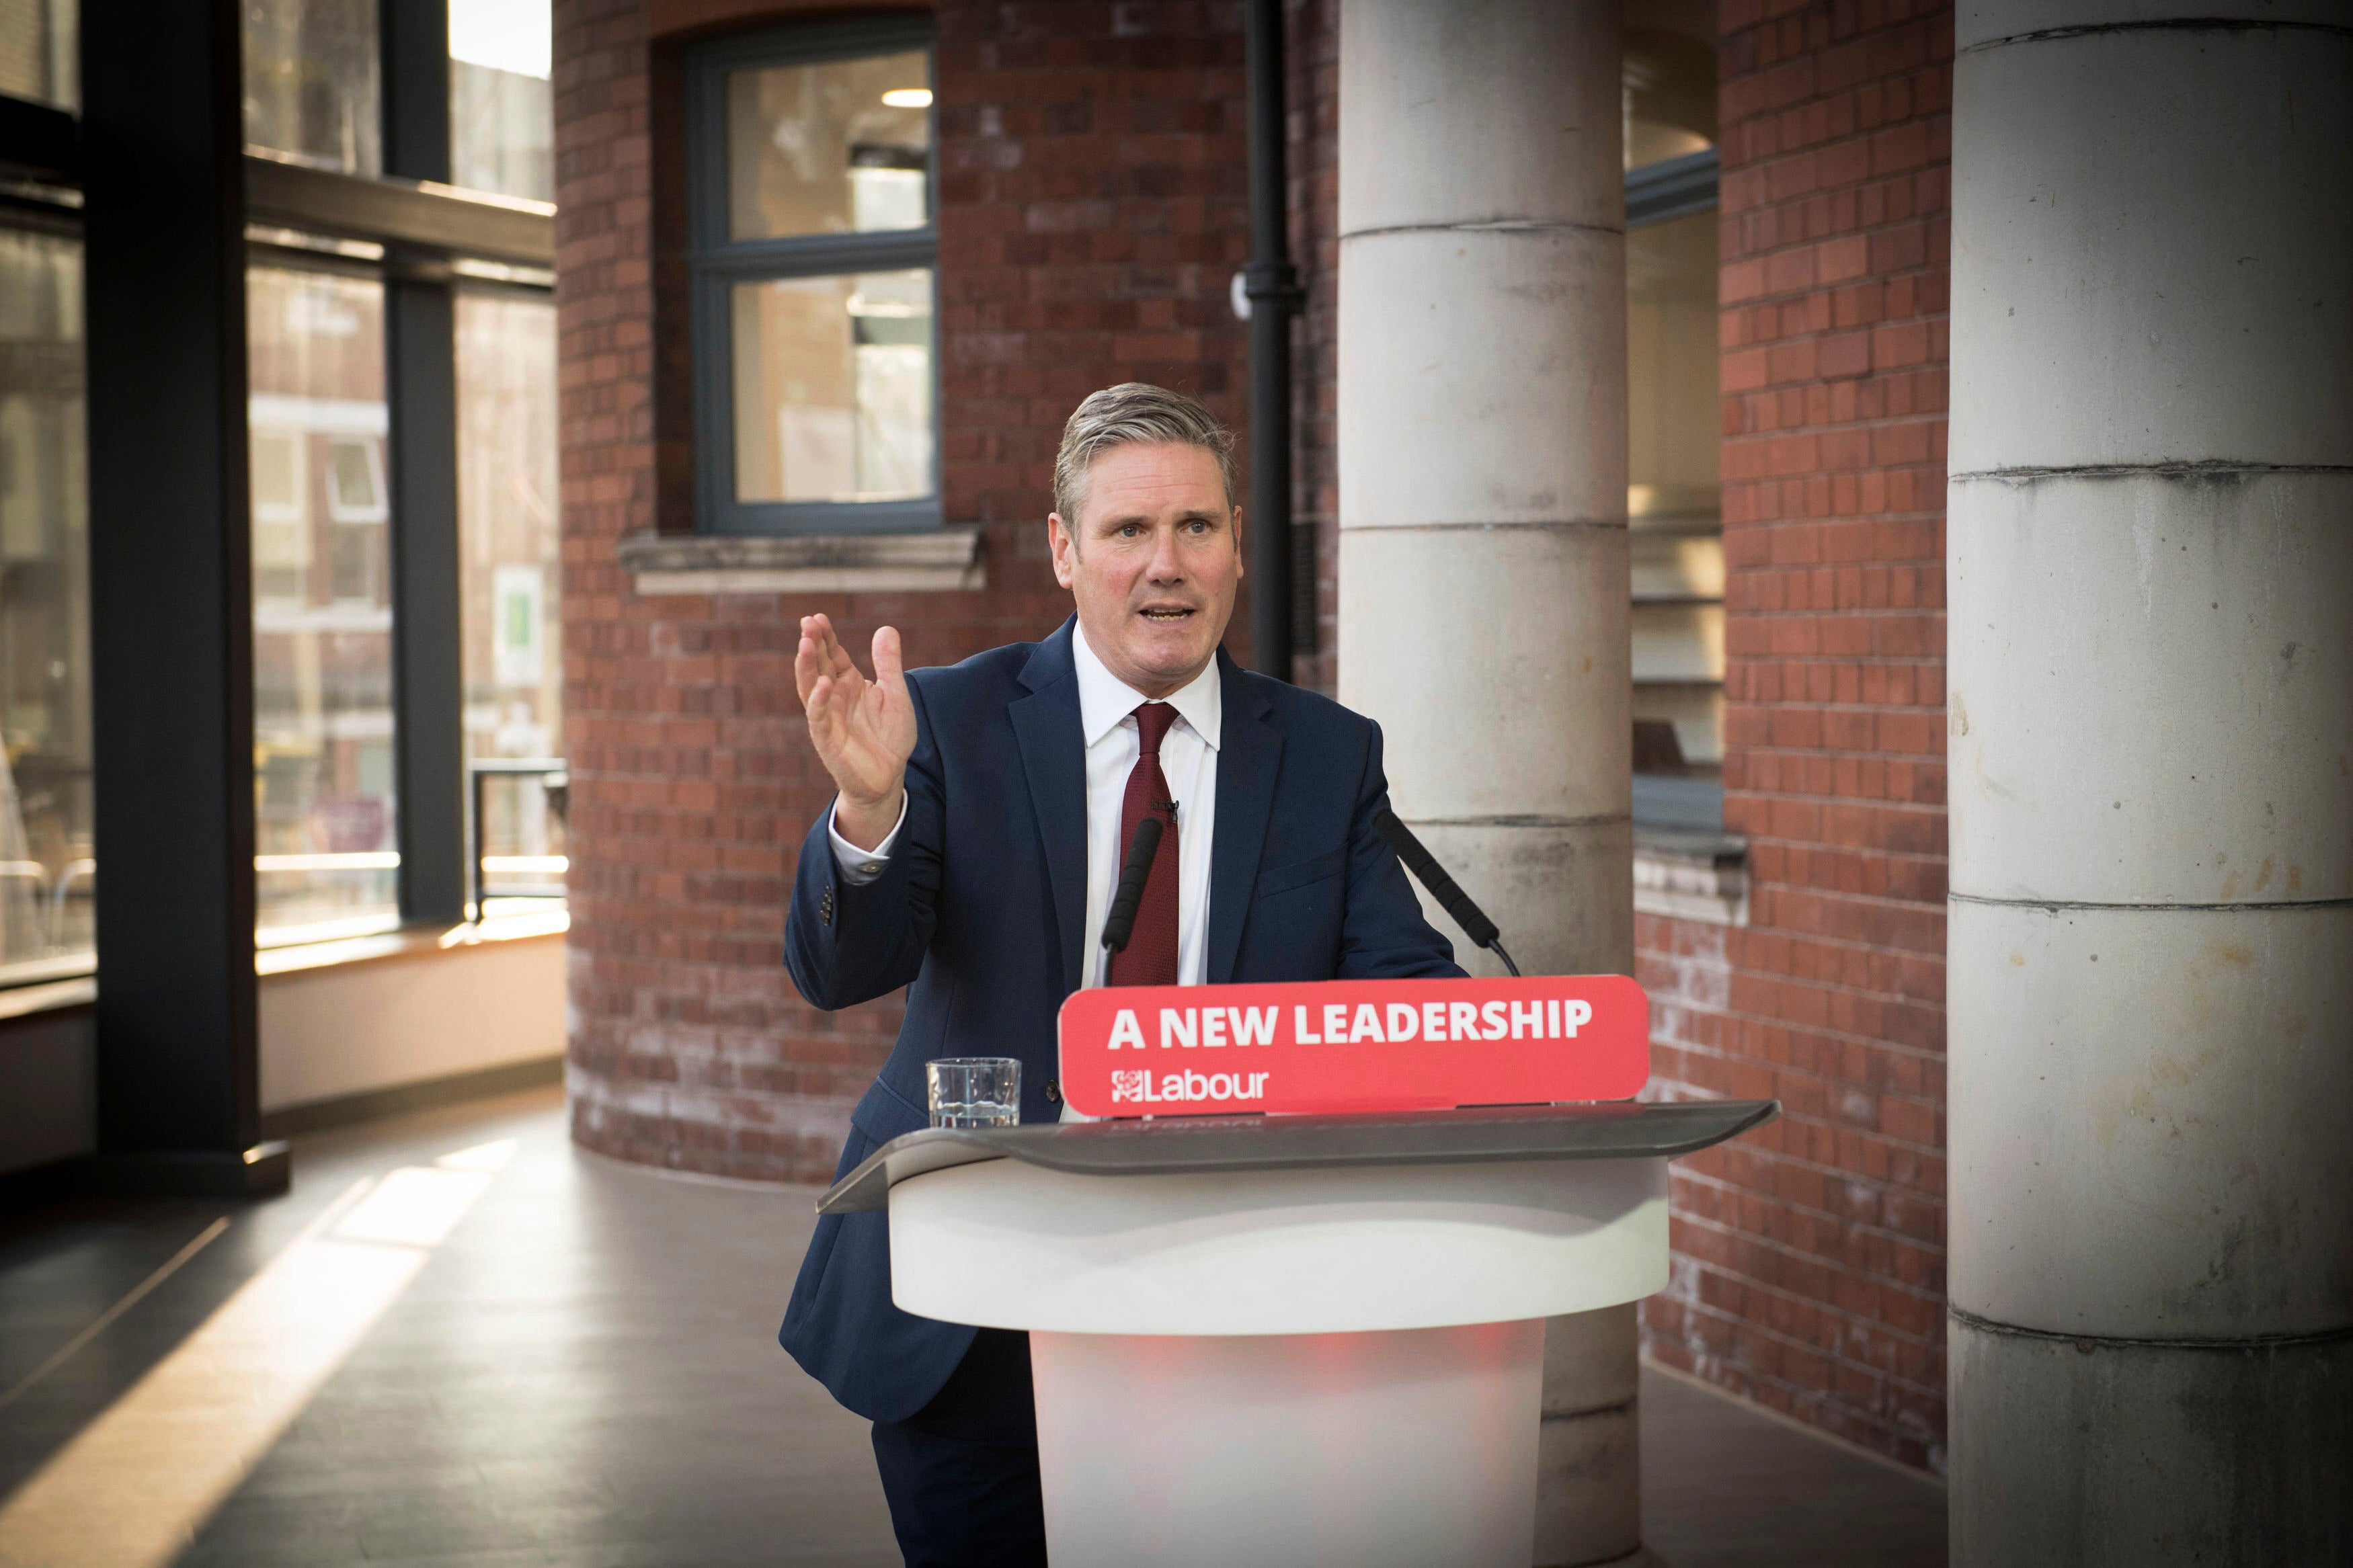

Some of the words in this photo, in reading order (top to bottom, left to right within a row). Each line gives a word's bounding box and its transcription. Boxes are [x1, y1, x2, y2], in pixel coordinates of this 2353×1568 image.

[1107, 1009, 1146, 1050] A
[1159, 1005, 1280, 1049] NEW
[1293, 999, 1593, 1045] LEADERSHIP
[1144, 1068, 1270, 1102] Labour
